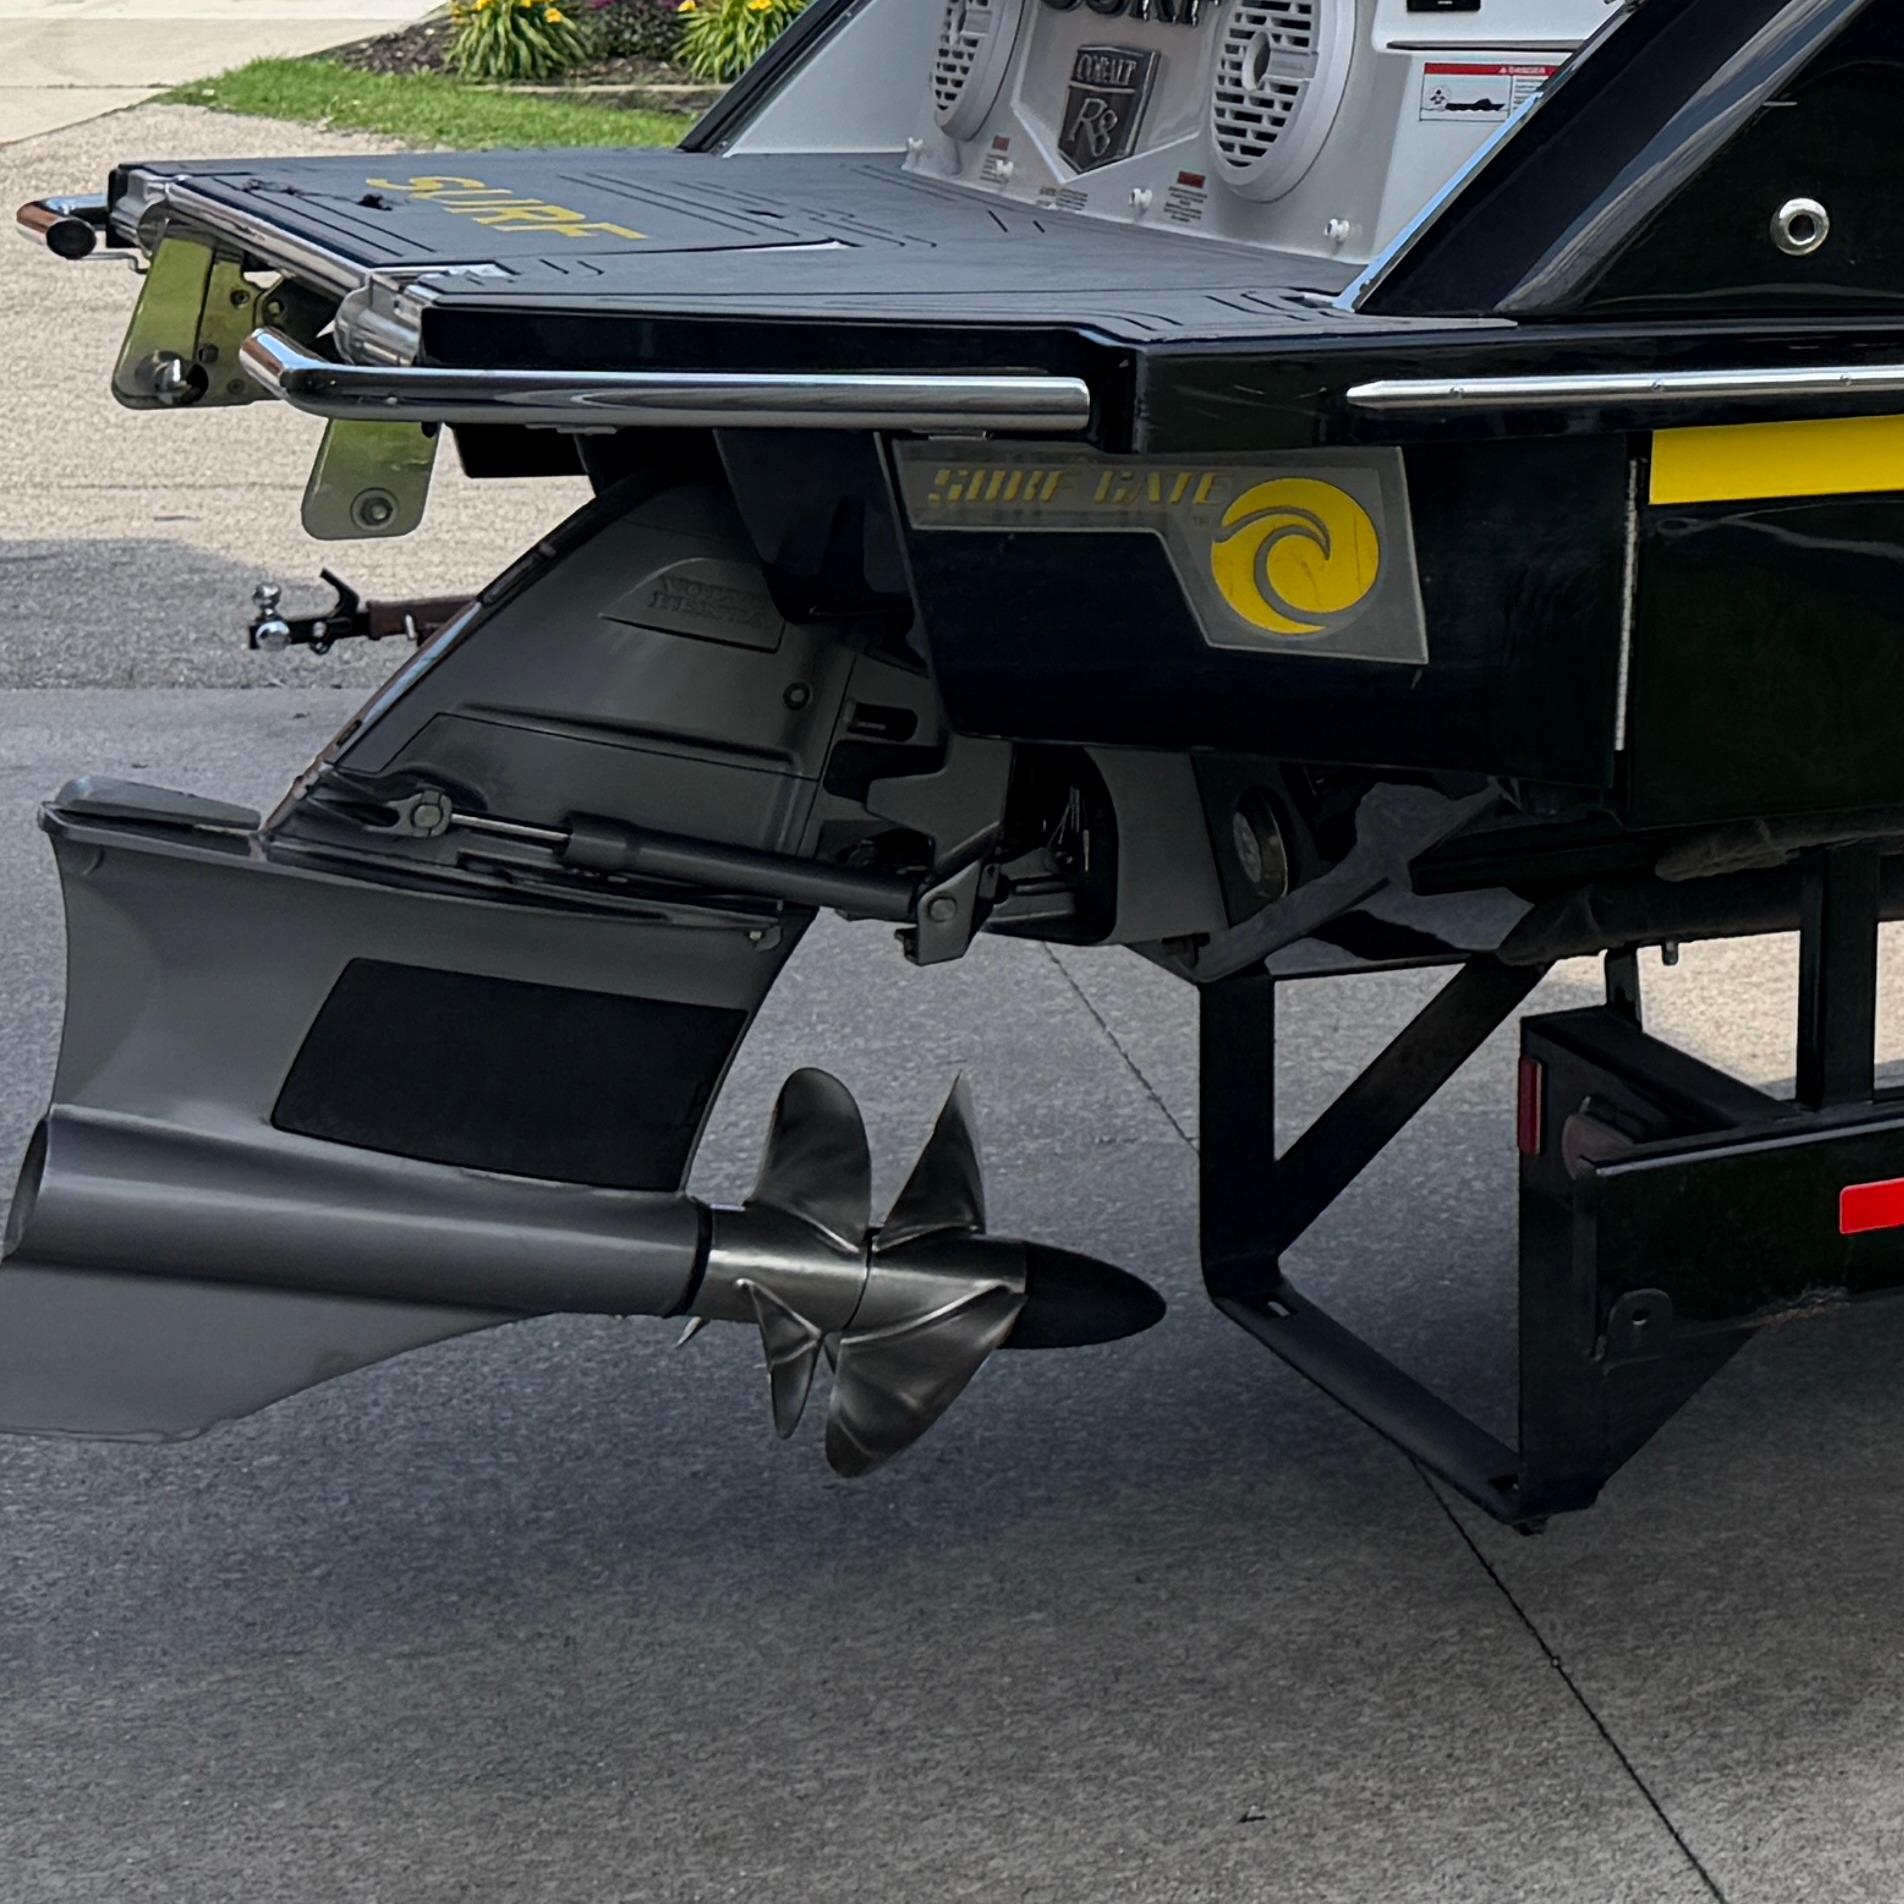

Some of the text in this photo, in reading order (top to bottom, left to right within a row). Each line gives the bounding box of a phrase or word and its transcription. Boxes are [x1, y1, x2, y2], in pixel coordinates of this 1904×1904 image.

[1076, 52, 1137, 86] COBALT
[1068, 97, 1119, 157] R8
[365, 175, 650, 240] SURF
[927, 468, 1080, 505] SURF
[1093, 470, 1233, 506] GATE
